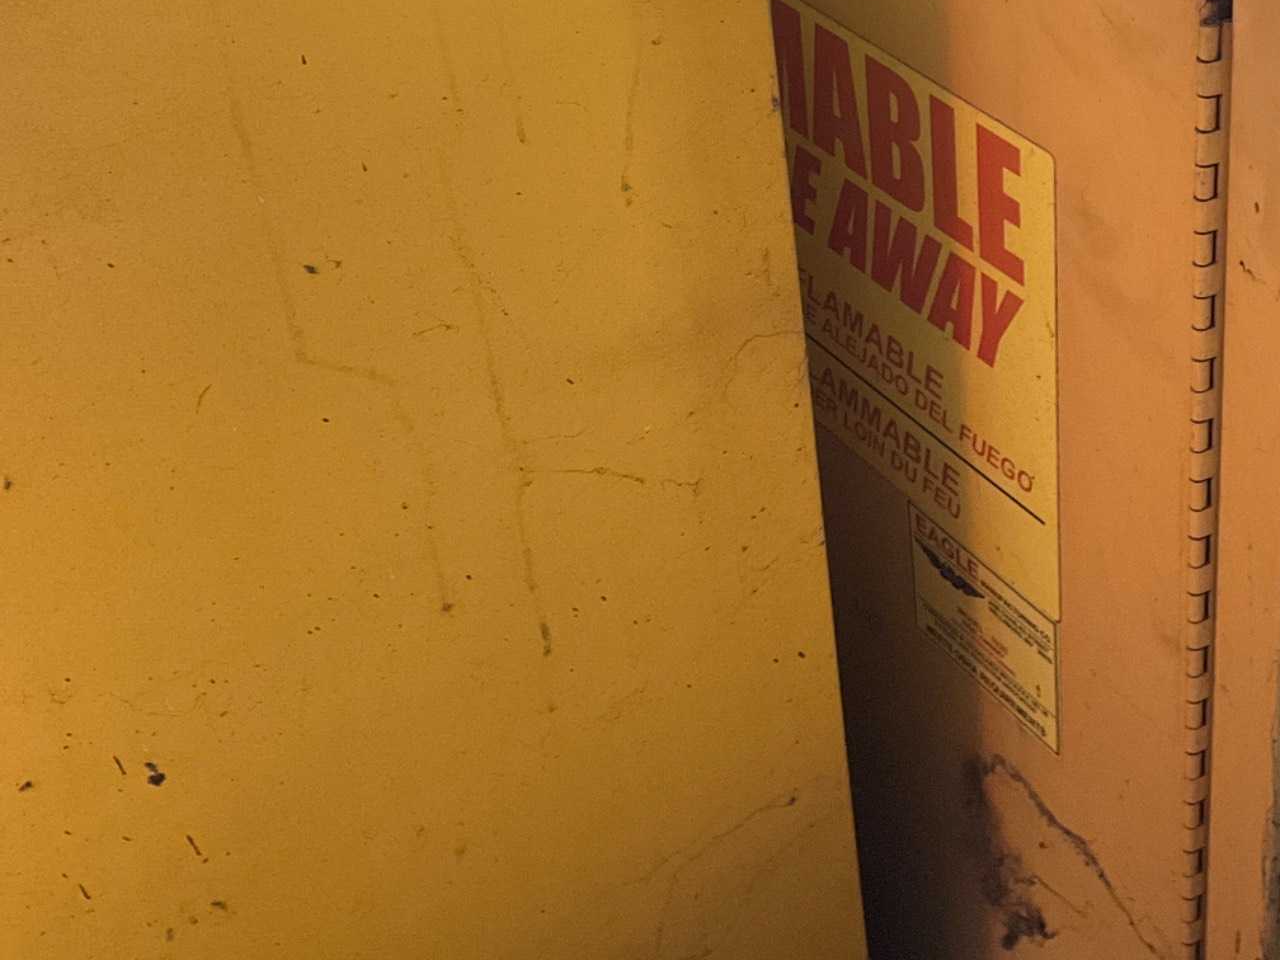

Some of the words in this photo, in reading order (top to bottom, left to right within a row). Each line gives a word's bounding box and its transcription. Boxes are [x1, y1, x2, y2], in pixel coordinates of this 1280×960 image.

[827, 177, 1025, 369] AWAY
[822, 318, 907, 396] ALEJADO
[914, 389, 953, 435] DEL
[959, 423, 1035, 493] FUEGO
[843, 411, 886, 458] LOIN
[890, 449, 918, 483] DU
[922, 477, 962, 519] FEU
[914, 513, 978, 581] EAGLE
